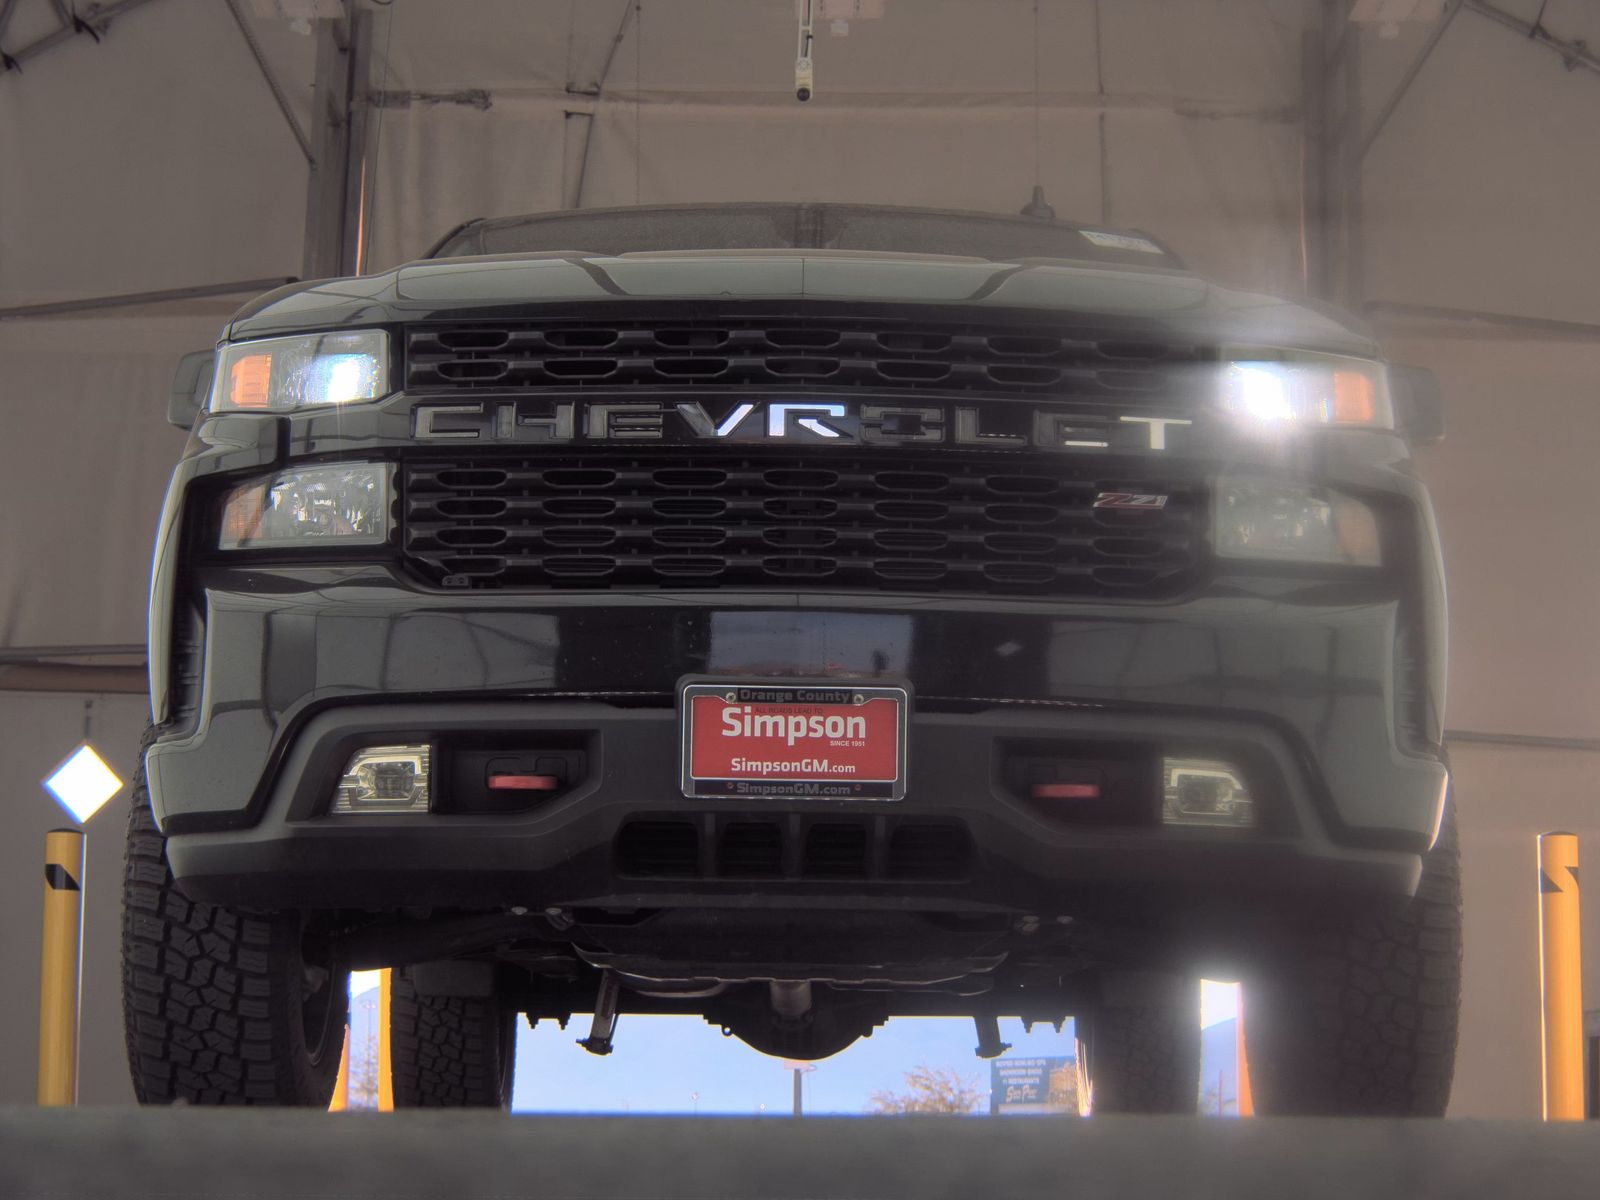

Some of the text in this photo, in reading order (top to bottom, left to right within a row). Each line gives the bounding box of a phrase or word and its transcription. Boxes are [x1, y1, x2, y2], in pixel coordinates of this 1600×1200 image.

[410, 401, 1193, 450] CHEVROLET
[740, 689, 850, 703] Orange County
[721, 706, 866, 746] Simpson
[731, 758, 856, 775] SimpsonGM.com
[736, 782, 851, 795] SimpsonGM.com
